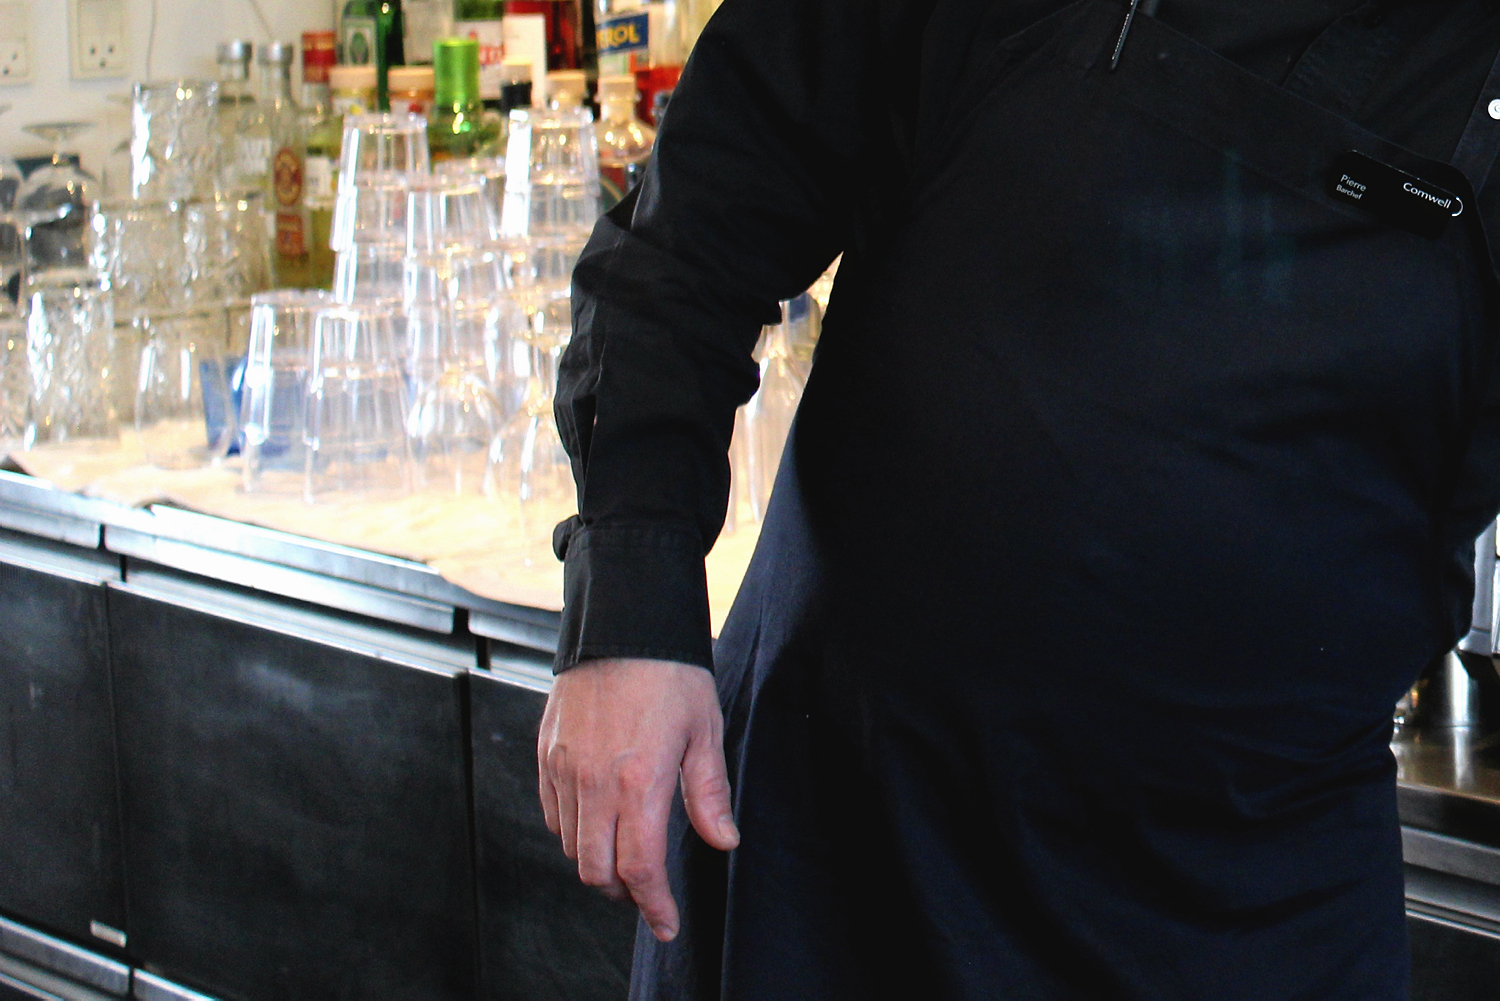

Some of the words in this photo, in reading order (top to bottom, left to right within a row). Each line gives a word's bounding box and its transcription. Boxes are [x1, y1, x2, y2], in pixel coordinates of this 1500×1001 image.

[1336, 184, 1363, 200] Barchef
[1340, 174, 1367, 192] Pierre
[1402, 182, 1452, 209] Comwell
